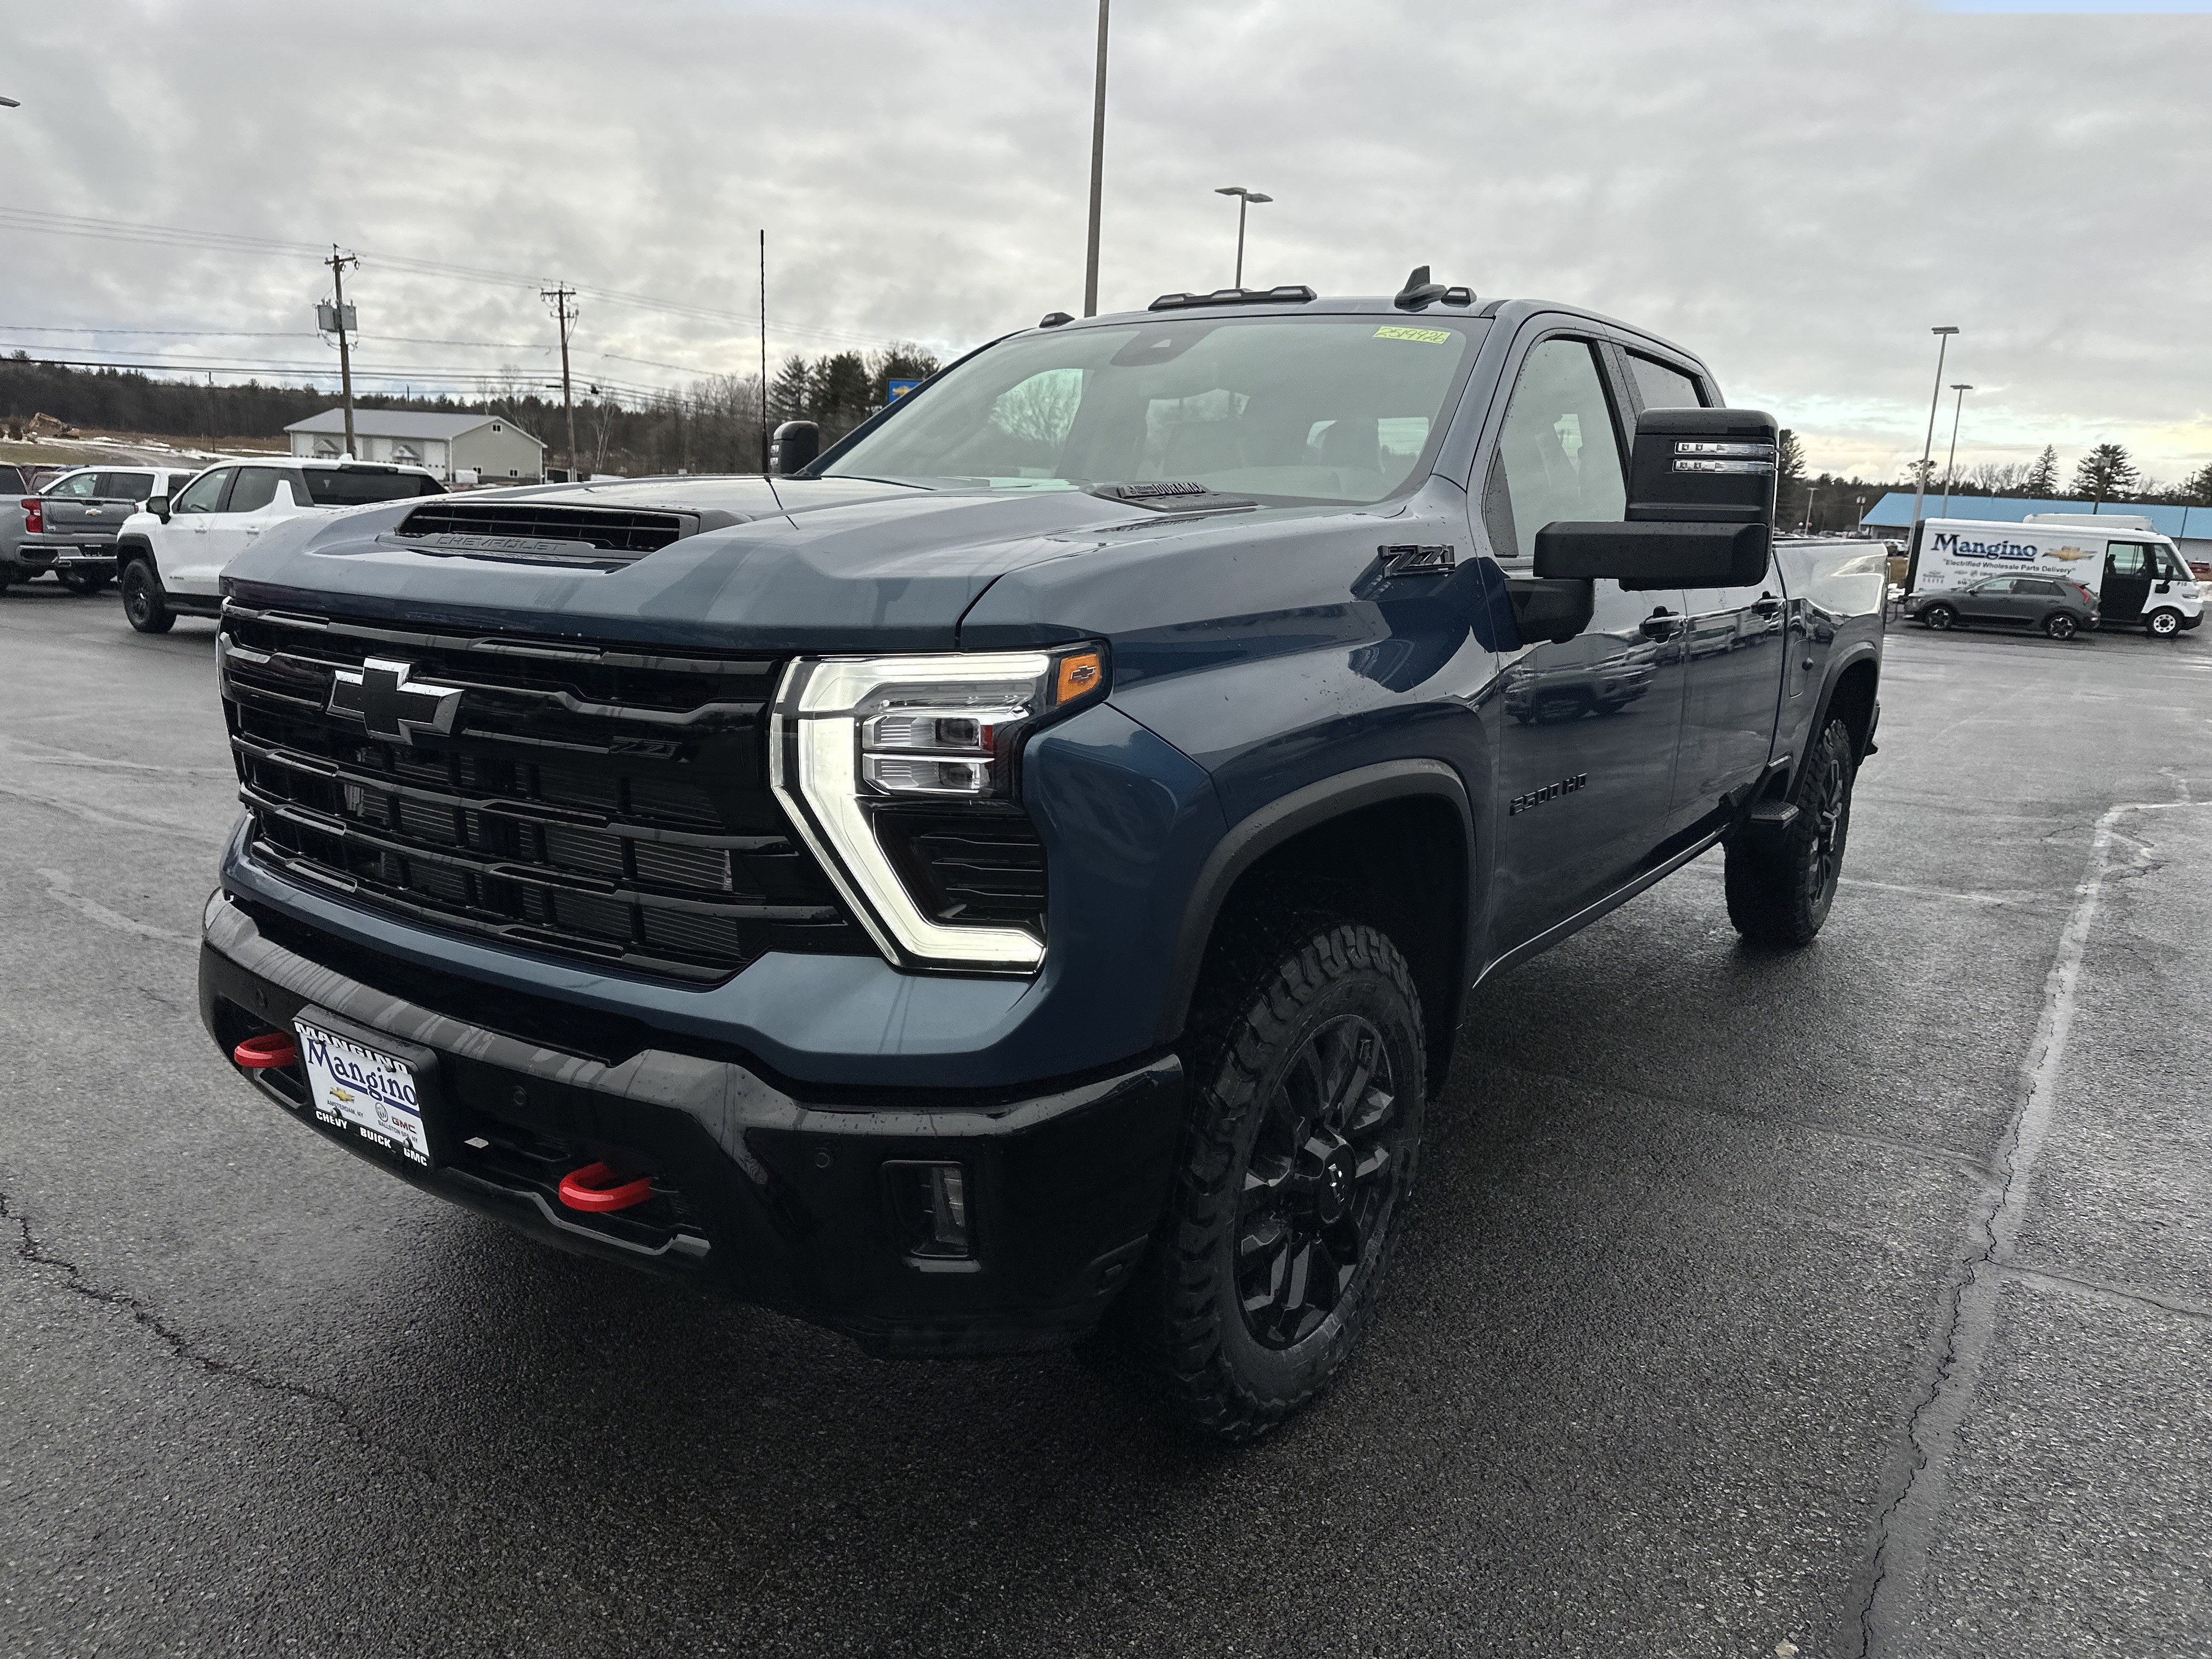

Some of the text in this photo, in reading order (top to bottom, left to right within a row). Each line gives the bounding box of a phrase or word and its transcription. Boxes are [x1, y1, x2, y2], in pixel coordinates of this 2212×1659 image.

[1152, 482, 1206, 495] DURAMAX
[437, 536, 567, 551] CHEVROLET
[1931, 533, 2038, 561] Mangino
[1982, 562, 2019, 571] Wholesale
[2021, 563, 2040, 572] Parts
[1509, 772, 1587, 816] 2500 HD
[294, 1022, 410, 1075] MANGINO
[308, 1037, 417, 1106] Mangino
[378, 1119, 400, 1135] BALLSTON
[391, 1116, 417, 1134] GMC
[315, 1110, 427, 1166] CHEVY BUICK GMC
